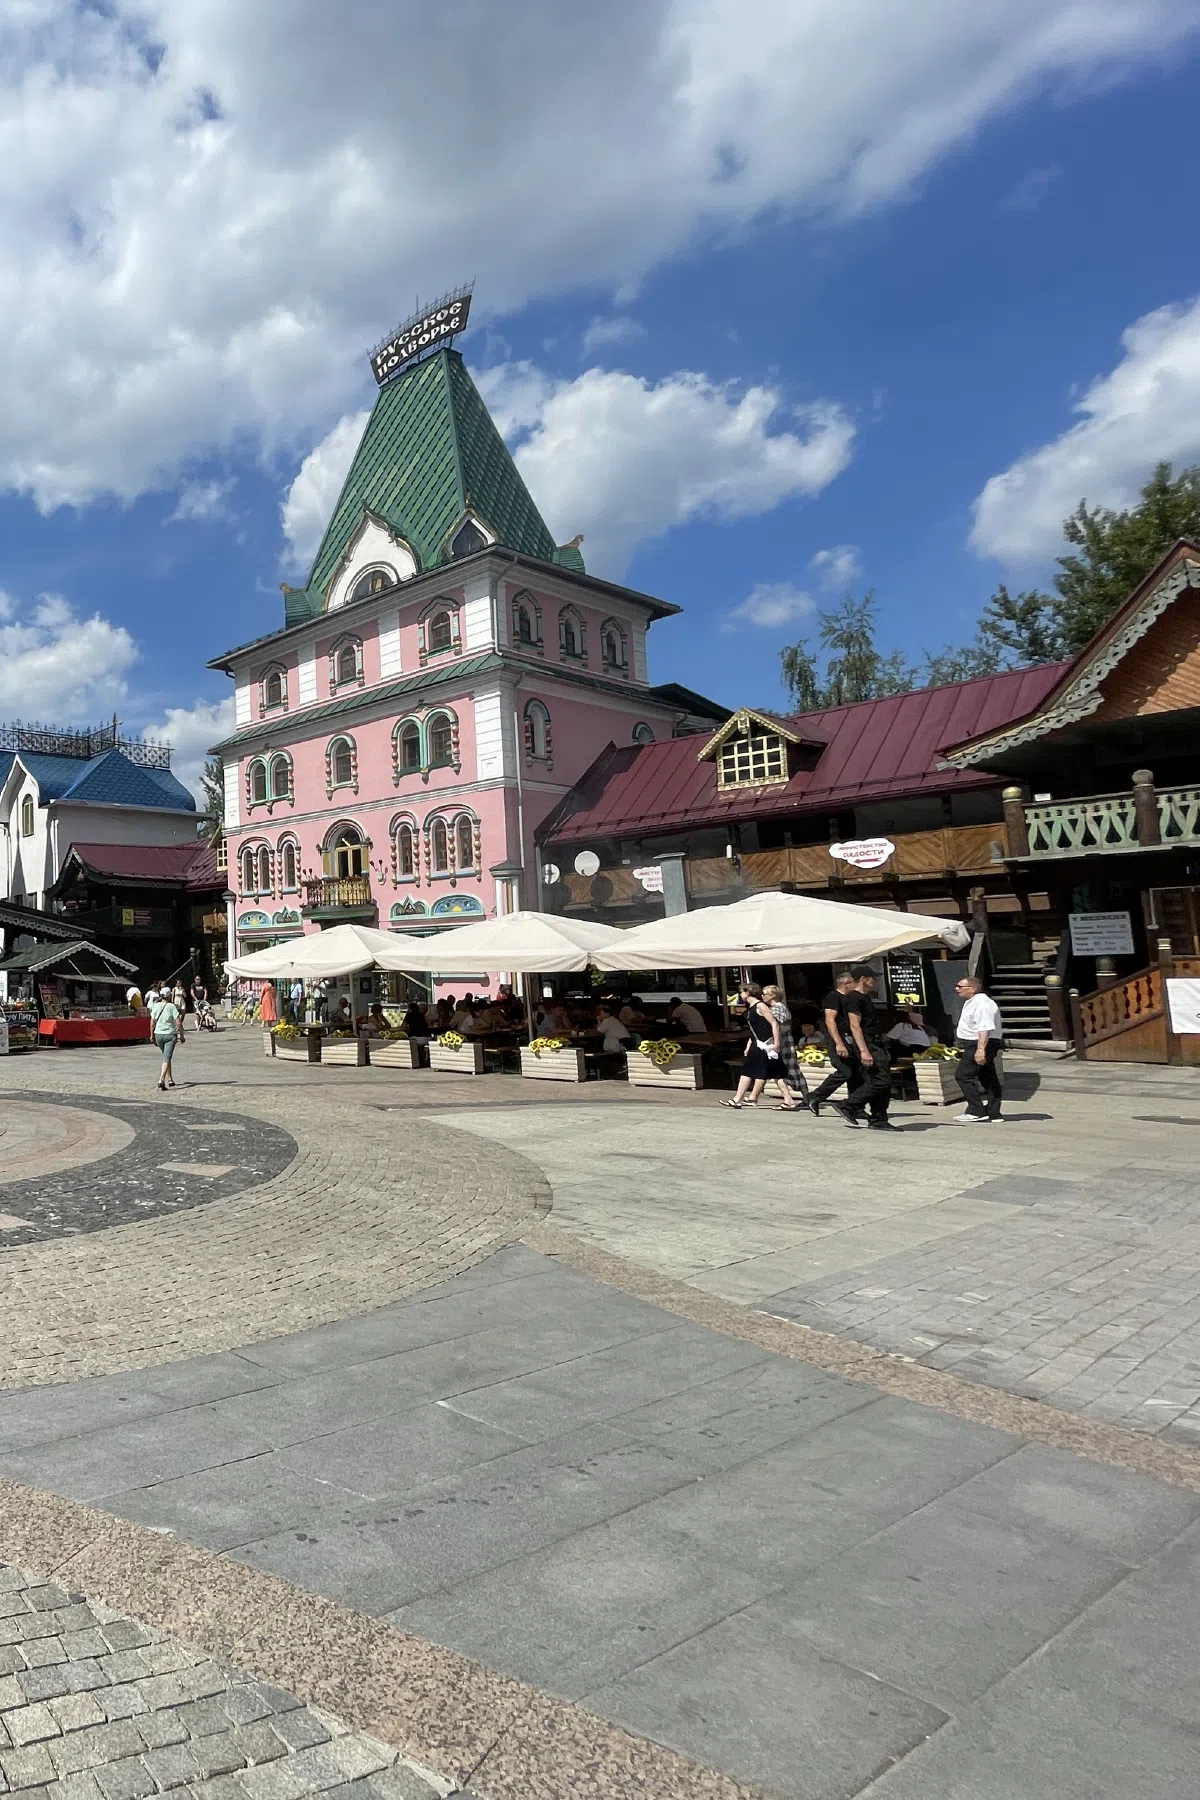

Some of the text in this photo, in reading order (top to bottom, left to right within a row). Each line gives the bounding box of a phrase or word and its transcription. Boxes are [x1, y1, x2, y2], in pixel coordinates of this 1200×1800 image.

[375, 302, 463, 366] РУССКОЕ
[377, 316, 461, 378] ПОДВОРЬЕ
[843, 850, 884, 858] РАДОСТИ
[18, 1013, 37, 1023] ПИТЬ
